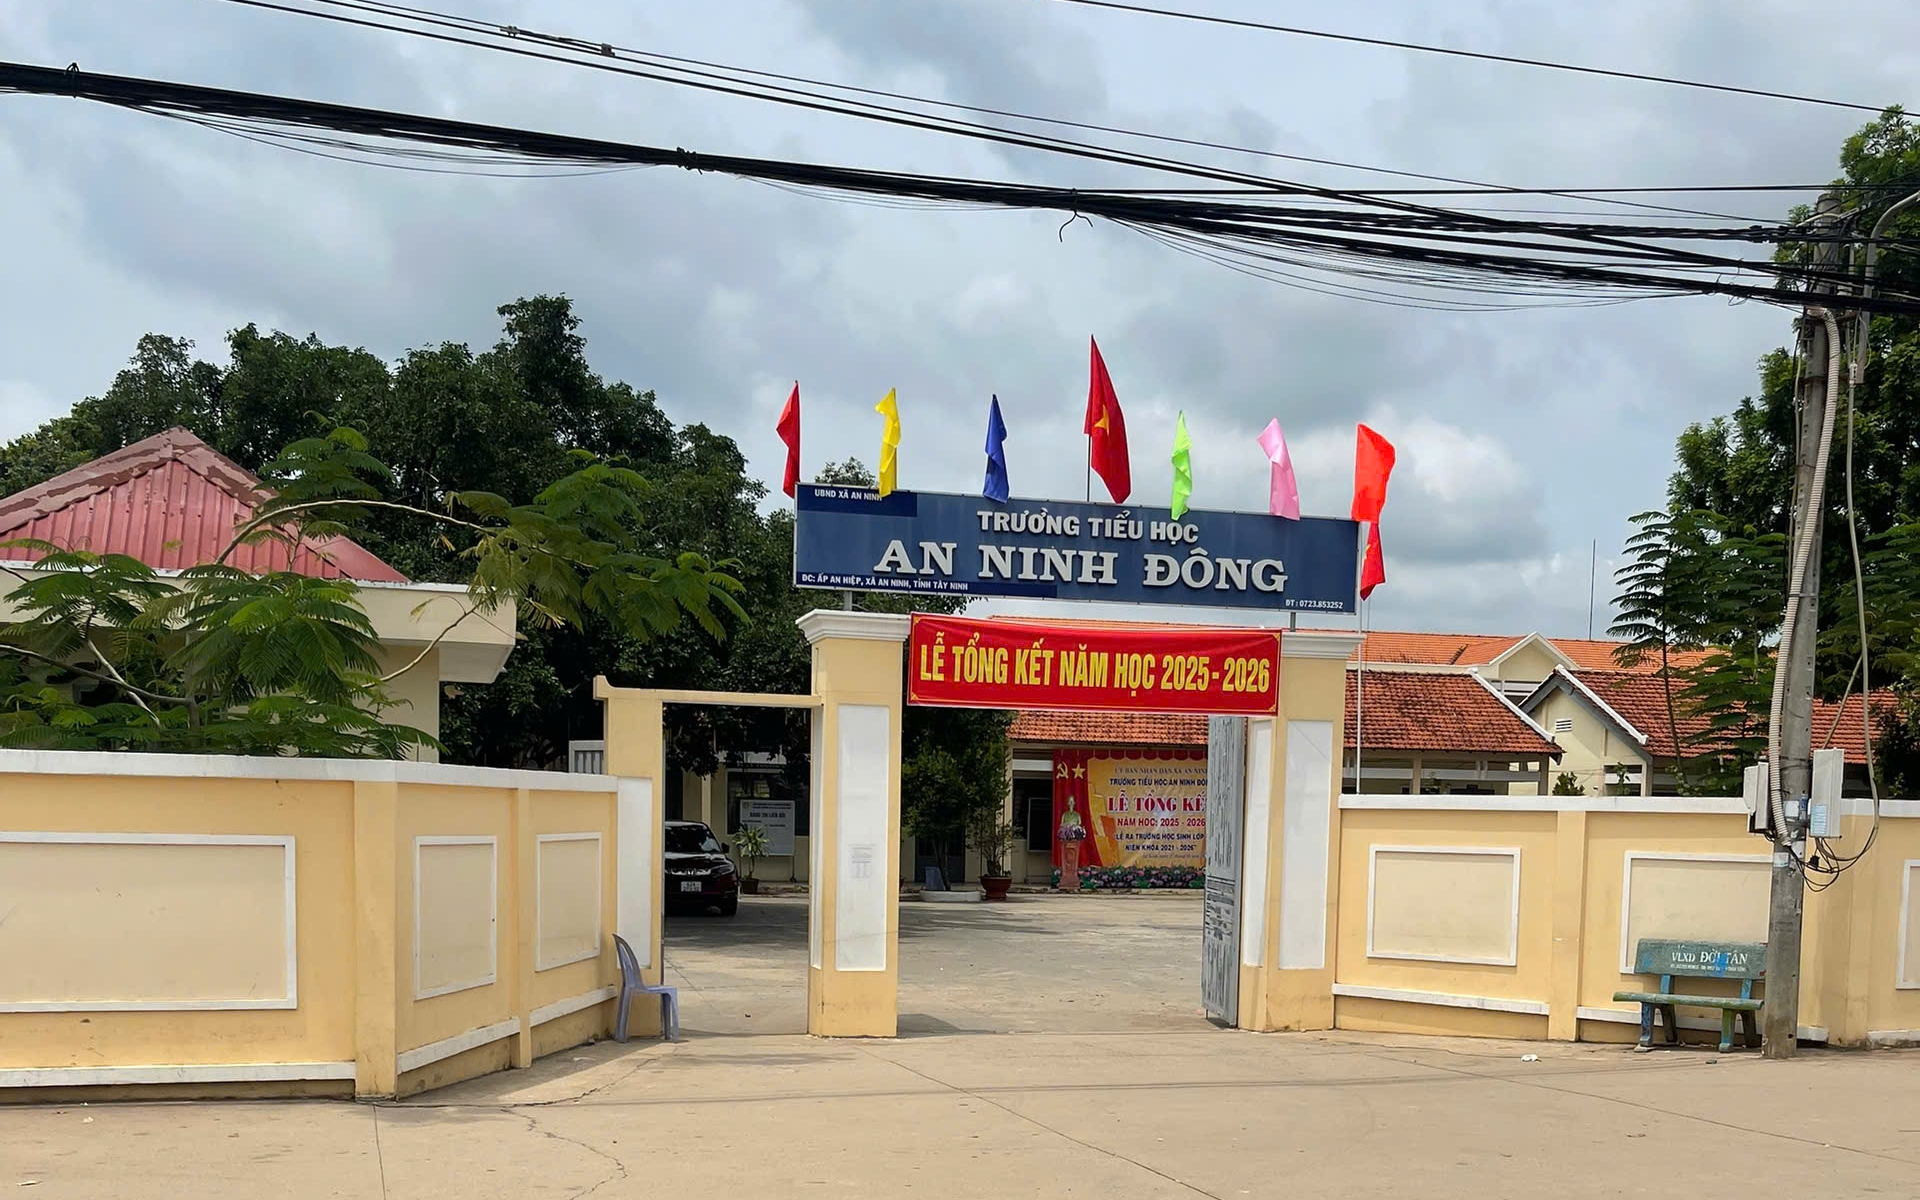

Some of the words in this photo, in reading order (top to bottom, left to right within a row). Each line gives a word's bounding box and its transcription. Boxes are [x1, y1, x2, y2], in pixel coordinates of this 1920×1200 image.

[814, 488, 836, 498] UBND
[838, 489, 849, 499] XÃ
[851, 491, 862, 500] AN
[977, 507, 1080, 536] TRƯỜNG
[1088, 510, 1143, 540] TIỂU
[1150, 521, 1199, 545] HỌC
[873, 539, 957, 575] AN
[978, 544, 1118, 584] NINH
[1142, 547, 1288, 592] ĐÔNG
[817, 572, 829, 583] ẤP
[830, 576, 841, 584] AN
[843, 576, 864, 587] HIỆP,
[865, 577, 876, 586] XÃ
[878, 578, 889, 587] AN
[890, 579, 911, 589] NINH,
[914, 579, 931, 589] TỈNH
[933, 580, 948, 590] TÂY
[950, 582, 968, 591] NINH
[920, 631, 945, 682] LỄ
[952, 631, 1009, 684] TỔNG
[1014, 637, 1054, 686] KẾT
[1058, 643, 1108, 688] NĂM
[1113, 652, 1156, 697] HỌC
[1108, 789, 1128, 811] LỄ
[1133, 788, 1177, 812] TỔNG
[1182, 790, 1207, 812] KẾ
[1117, 815, 1136, 827] NĂM
[1160, 817, 1179, 827] 2025
[1186, 817, 1206, 827] 2026
[1671, 951, 1696, 963] VLXD
